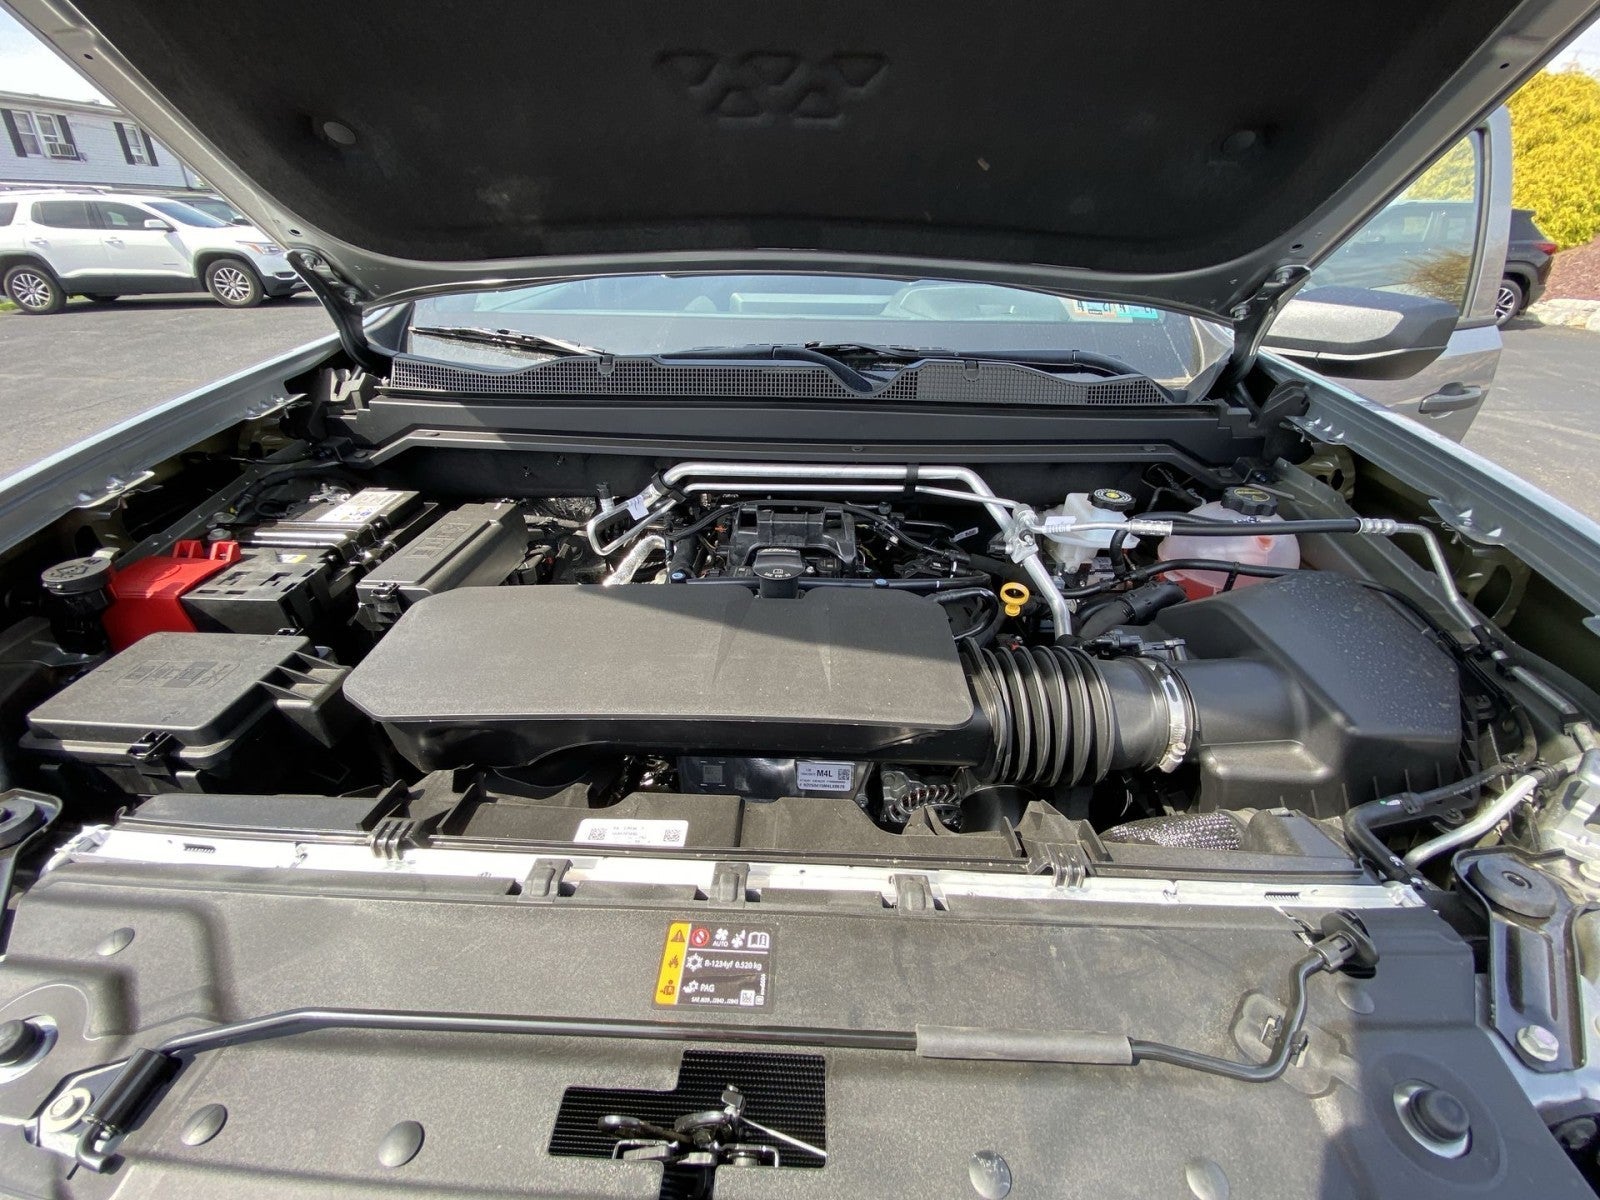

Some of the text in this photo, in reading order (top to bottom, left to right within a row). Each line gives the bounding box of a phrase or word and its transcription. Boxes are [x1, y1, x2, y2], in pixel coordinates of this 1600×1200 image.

[816, 769, 833, 777] M4L
[753, 961, 763, 971] kg
[700, 983, 715, 992] PAG
